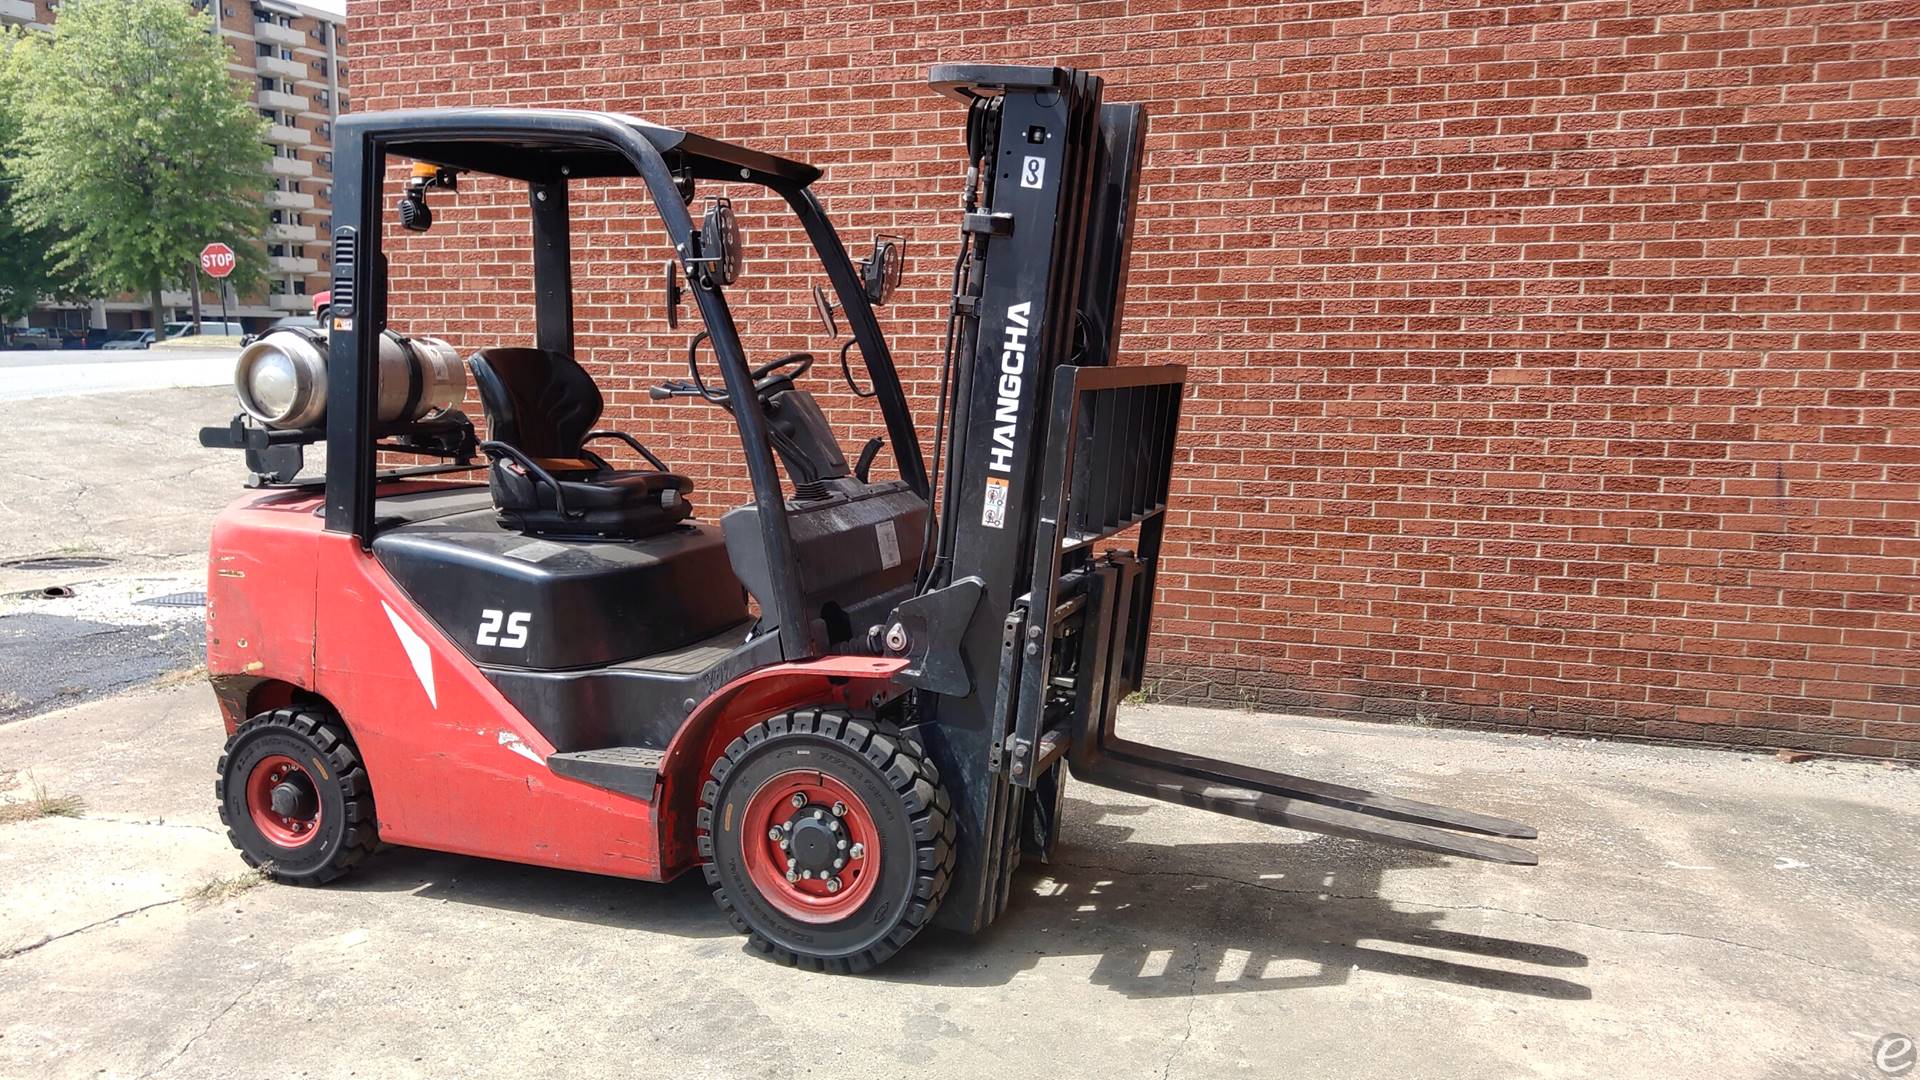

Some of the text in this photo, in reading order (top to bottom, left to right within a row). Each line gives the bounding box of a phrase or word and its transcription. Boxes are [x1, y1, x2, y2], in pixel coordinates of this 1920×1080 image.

[202, 253, 233, 268] STOP
[989, 301, 1032, 473] HANGCHA
[476, 608, 532, 649] 25
